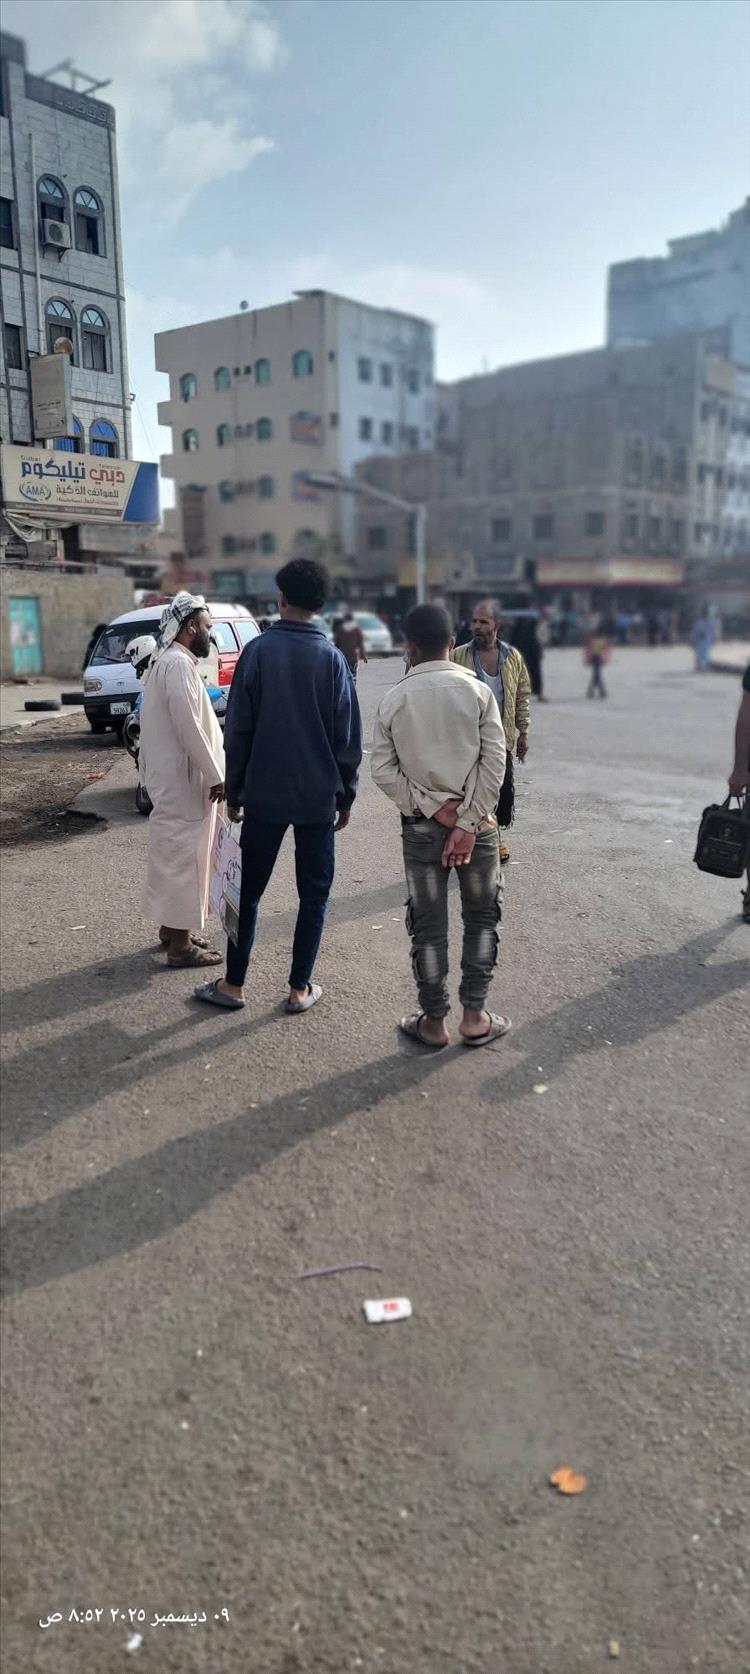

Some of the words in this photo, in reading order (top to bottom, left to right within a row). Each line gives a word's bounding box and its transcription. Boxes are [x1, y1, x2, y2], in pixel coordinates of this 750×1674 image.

[21, 457, 86, 483] تيليكوم
[89, 466, 126, 486] دبي
[26, 485, 46, 497] AMA
